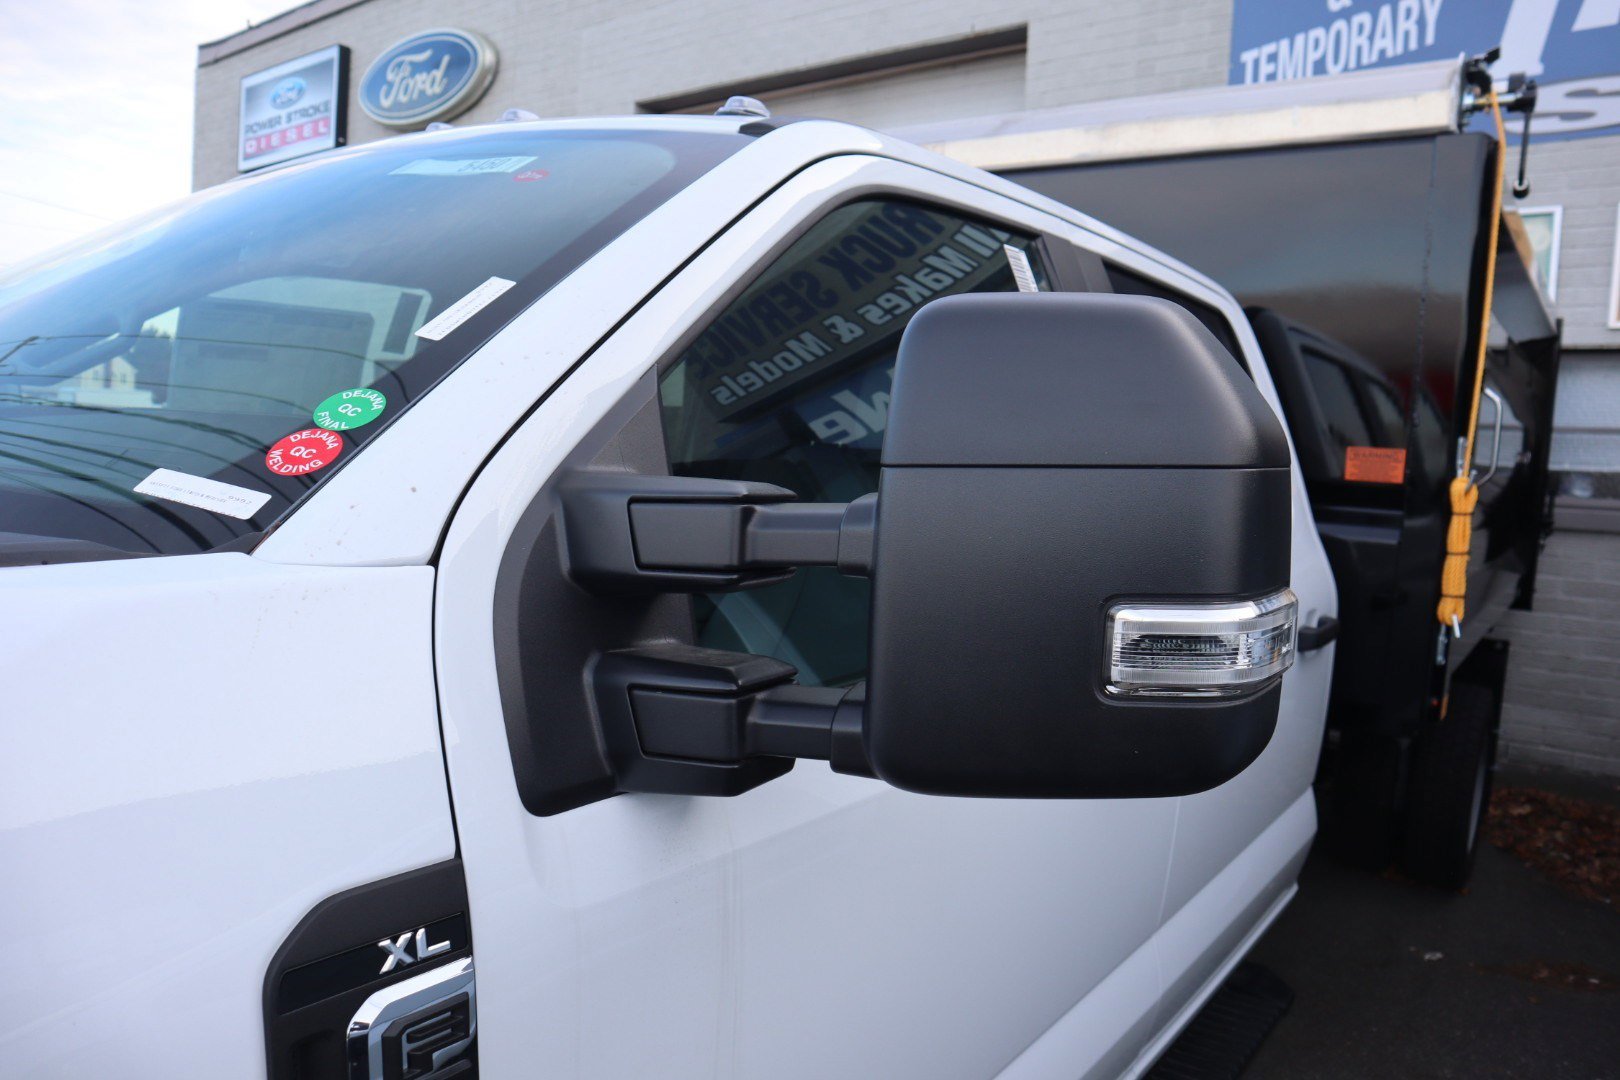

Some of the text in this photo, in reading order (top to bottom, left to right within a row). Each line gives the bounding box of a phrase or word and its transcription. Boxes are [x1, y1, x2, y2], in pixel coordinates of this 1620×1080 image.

[1239, 0, 1443, 85] TEMPORARY
[379, 48, 451, 109] Ford
[244, 100, 330, 133] POWER STROKE
[245, 119, 330, 155] DIESEL
[338, 403, 362, 417] QC
[342, 389, 384, 411] DEJANA
[317, 410, 349, 429] FINAL
[289, 446, 317, 459] QC
[290, 430, 339, 450] DEJANA
[268, 448, 324, 473] WELDING
[377, 927, 452, 975] XL
